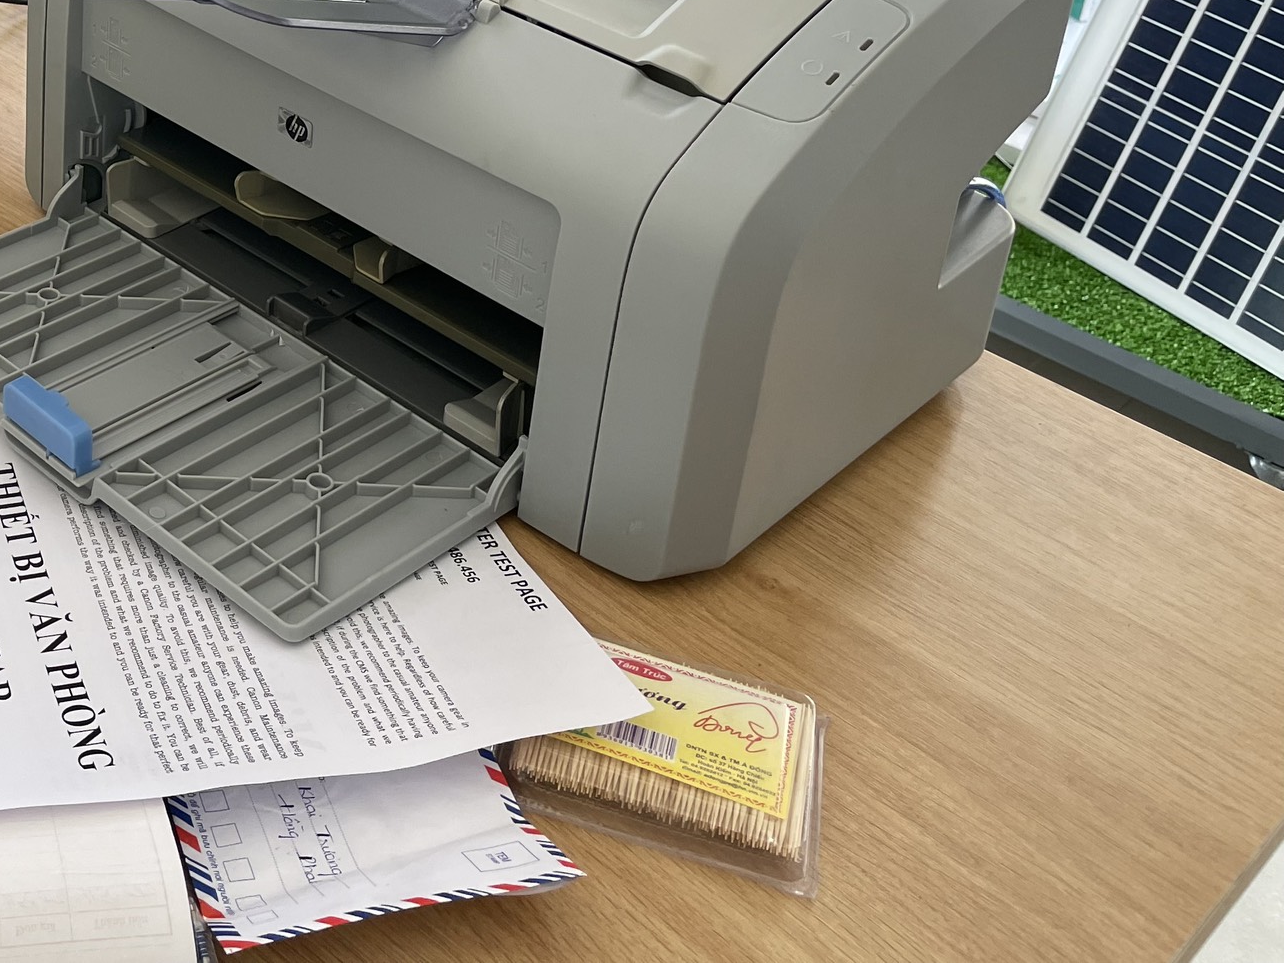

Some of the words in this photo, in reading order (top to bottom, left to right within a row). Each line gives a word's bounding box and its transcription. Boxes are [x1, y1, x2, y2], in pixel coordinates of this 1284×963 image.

[59, 491, 72, 515] camera
[66, 516, 84, 546] performs
[79, 546, 88, 558] the
[9, 552, 50, 584] BỊ
[83, 559, 94, 574] way
[177, 568, 194, 593] careful
[489, 550, 521, 576] TEST
[510, 579, 547, 611] PAGE
[92, 583, 102, 598] was
[185, 593, 199, 608] you
[25, 585, 72, 655] VĂN
[97, 599, 115, 630] intended
[194, 609, 205, 622] are
[200, 623, 213, 640] with
[112, 641, 125, 656] and
[205, 641, 221, 658] your
[116, 656, 129, 671] you
[382, 600, 400, 623] amazing
[397, 624, 413, 644] images.
[416, 654, 430, 669] keep
[424, 669, 439, 683] your
[436, 684, 454, 706] camera
[448, 707, 464, 720] gear
[215, 660, 230, 679] gear,
[123, 672, 135, 686] can
[226, 680, 240, 699] dust,
[45, 660, 117, 772] PHÒNG
[134, 697, 148, 719] ready
[235, 700, 252, 726] debris,
[142, 720, 154, 732] for
[248, 727, 263, 742] and
[148, 732, 162, 749] that
[256, 742, 272, 760] wear
[153, 749, 174, 773] perfect
